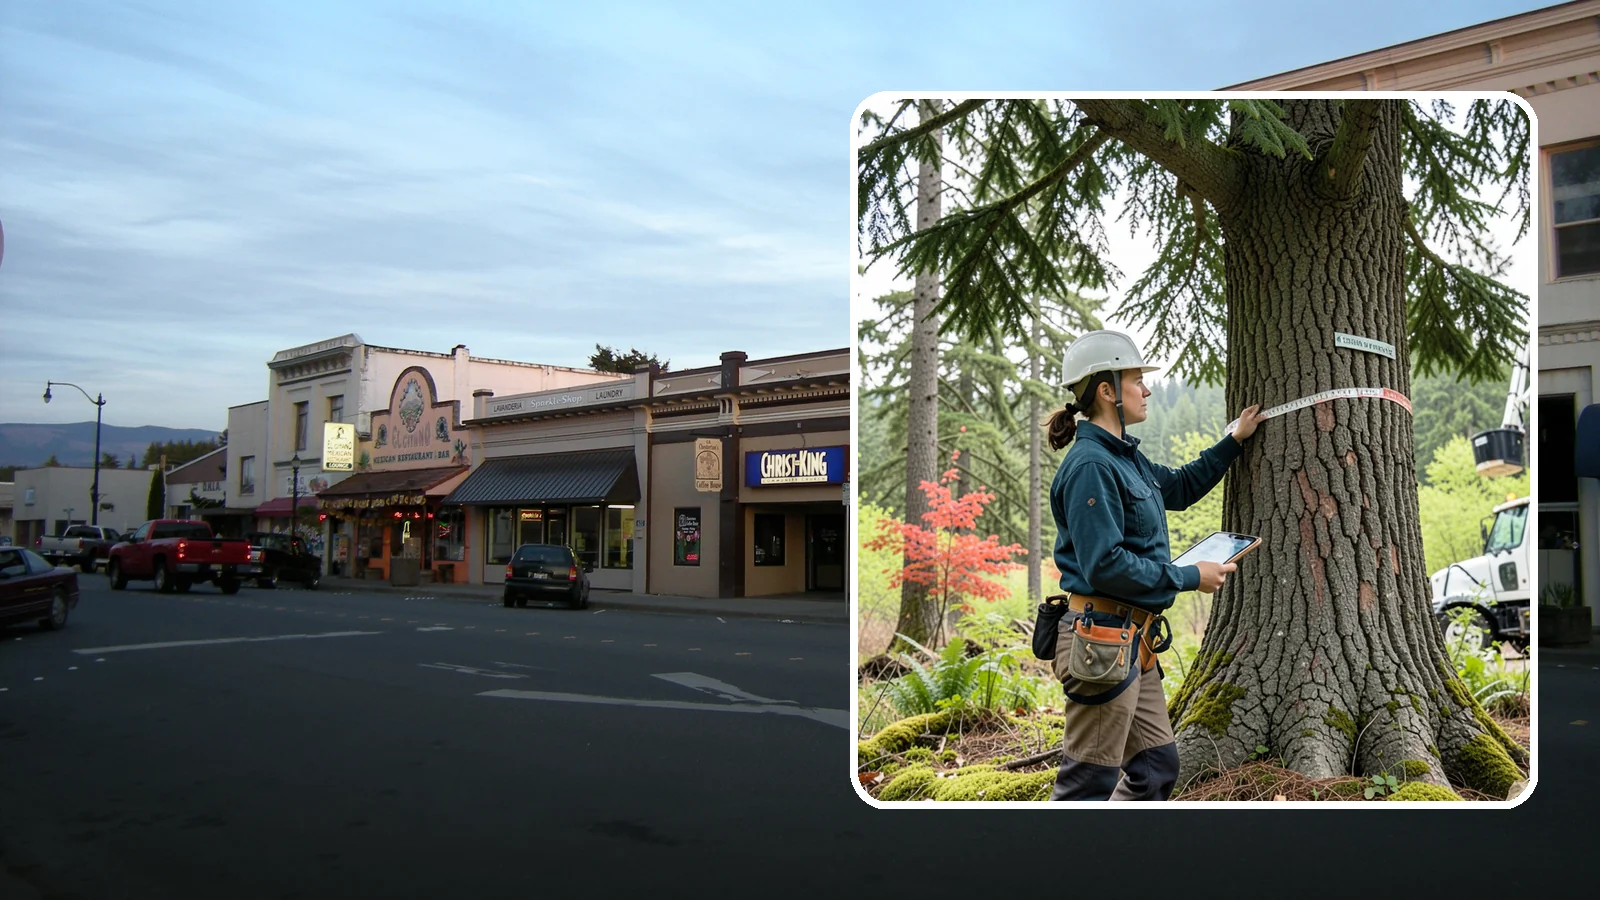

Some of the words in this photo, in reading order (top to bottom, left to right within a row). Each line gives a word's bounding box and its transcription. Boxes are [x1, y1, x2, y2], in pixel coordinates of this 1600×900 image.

[531, 396, 562, 409] Sparkle
[561, 394, 583, 404] Shop
[595, 389, 624, 400] LAUNDRY
[493, 402, 523, 412] LAVANDERIA
[392, 425, 401, 449] EL
[373, 455, 396, 464] MEXICAN
[398, 452, 433, 462] RESTAURANT
[438, 450, 450, 459] BAR
[761, 452, 797, 478] CHRIST
[799, 450, 827, 476] KING
